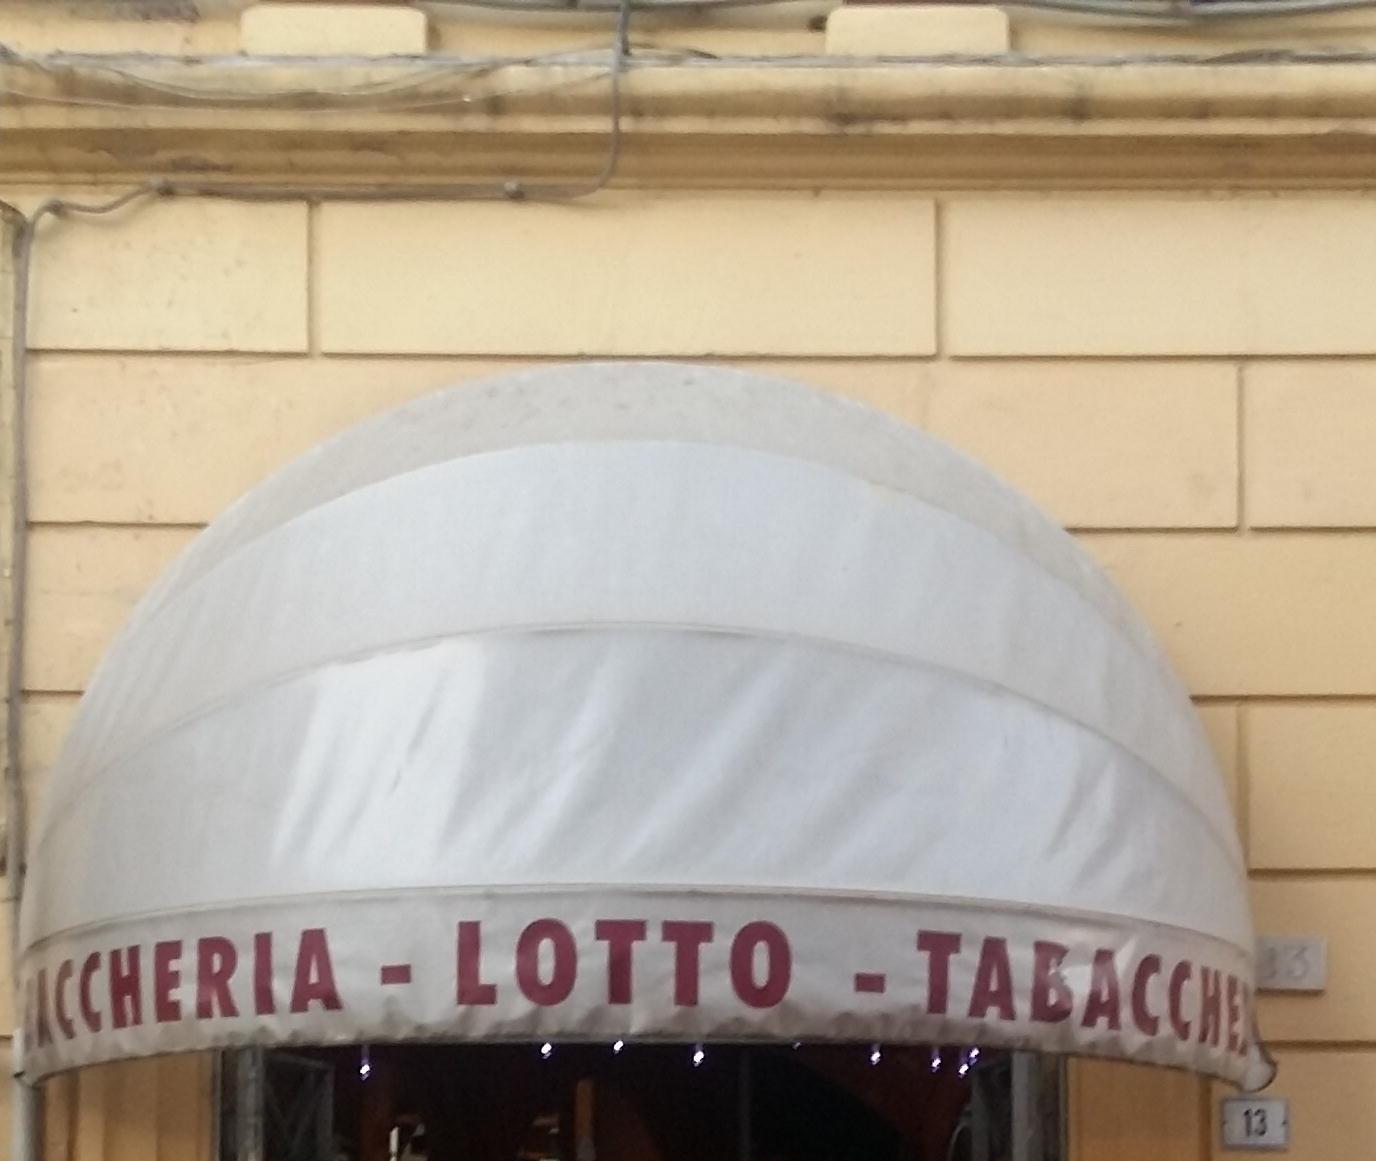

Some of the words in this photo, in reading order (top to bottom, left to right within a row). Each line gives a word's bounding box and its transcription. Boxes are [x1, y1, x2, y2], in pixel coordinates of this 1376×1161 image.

[26, 927, 343, 1050] ACCHERIA
[455, 918, 792, 1009] LOTTO
[916, 929, 1248, 1058] TABACCHE
[1243, 1107, 1268, 1137] 13
